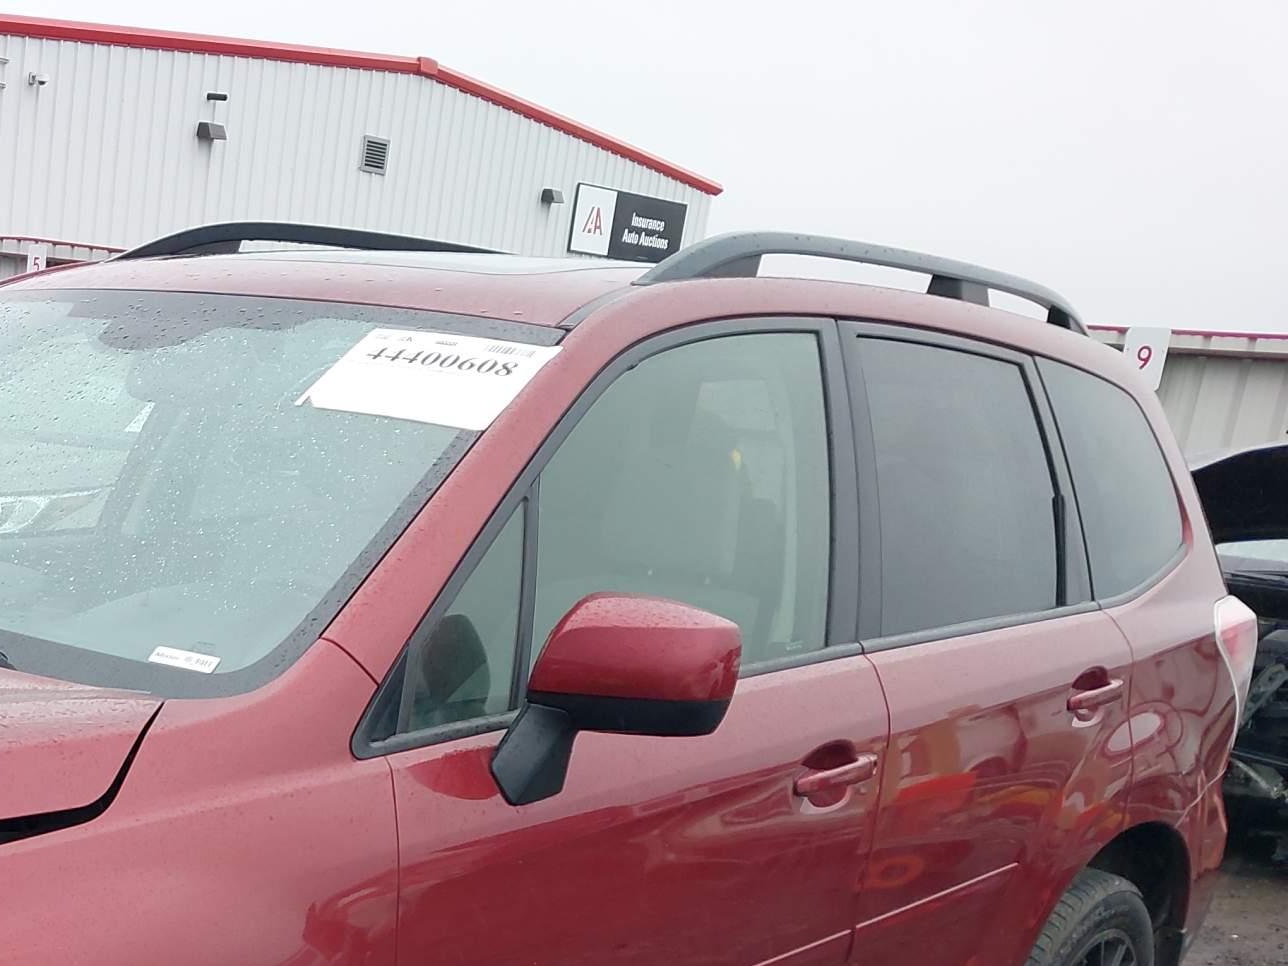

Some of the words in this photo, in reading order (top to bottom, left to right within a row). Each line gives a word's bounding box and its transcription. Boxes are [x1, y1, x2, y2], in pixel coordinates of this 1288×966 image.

[631, 212, 665, 232] Insurance
[621, 228, 639, 244] Auto
[638, 231, 669, 250] Auctions
[33, 256, 40, 271] 5
[366, 346, 519, 376] 44400608
[1137, 345, 1153, 370] 9
